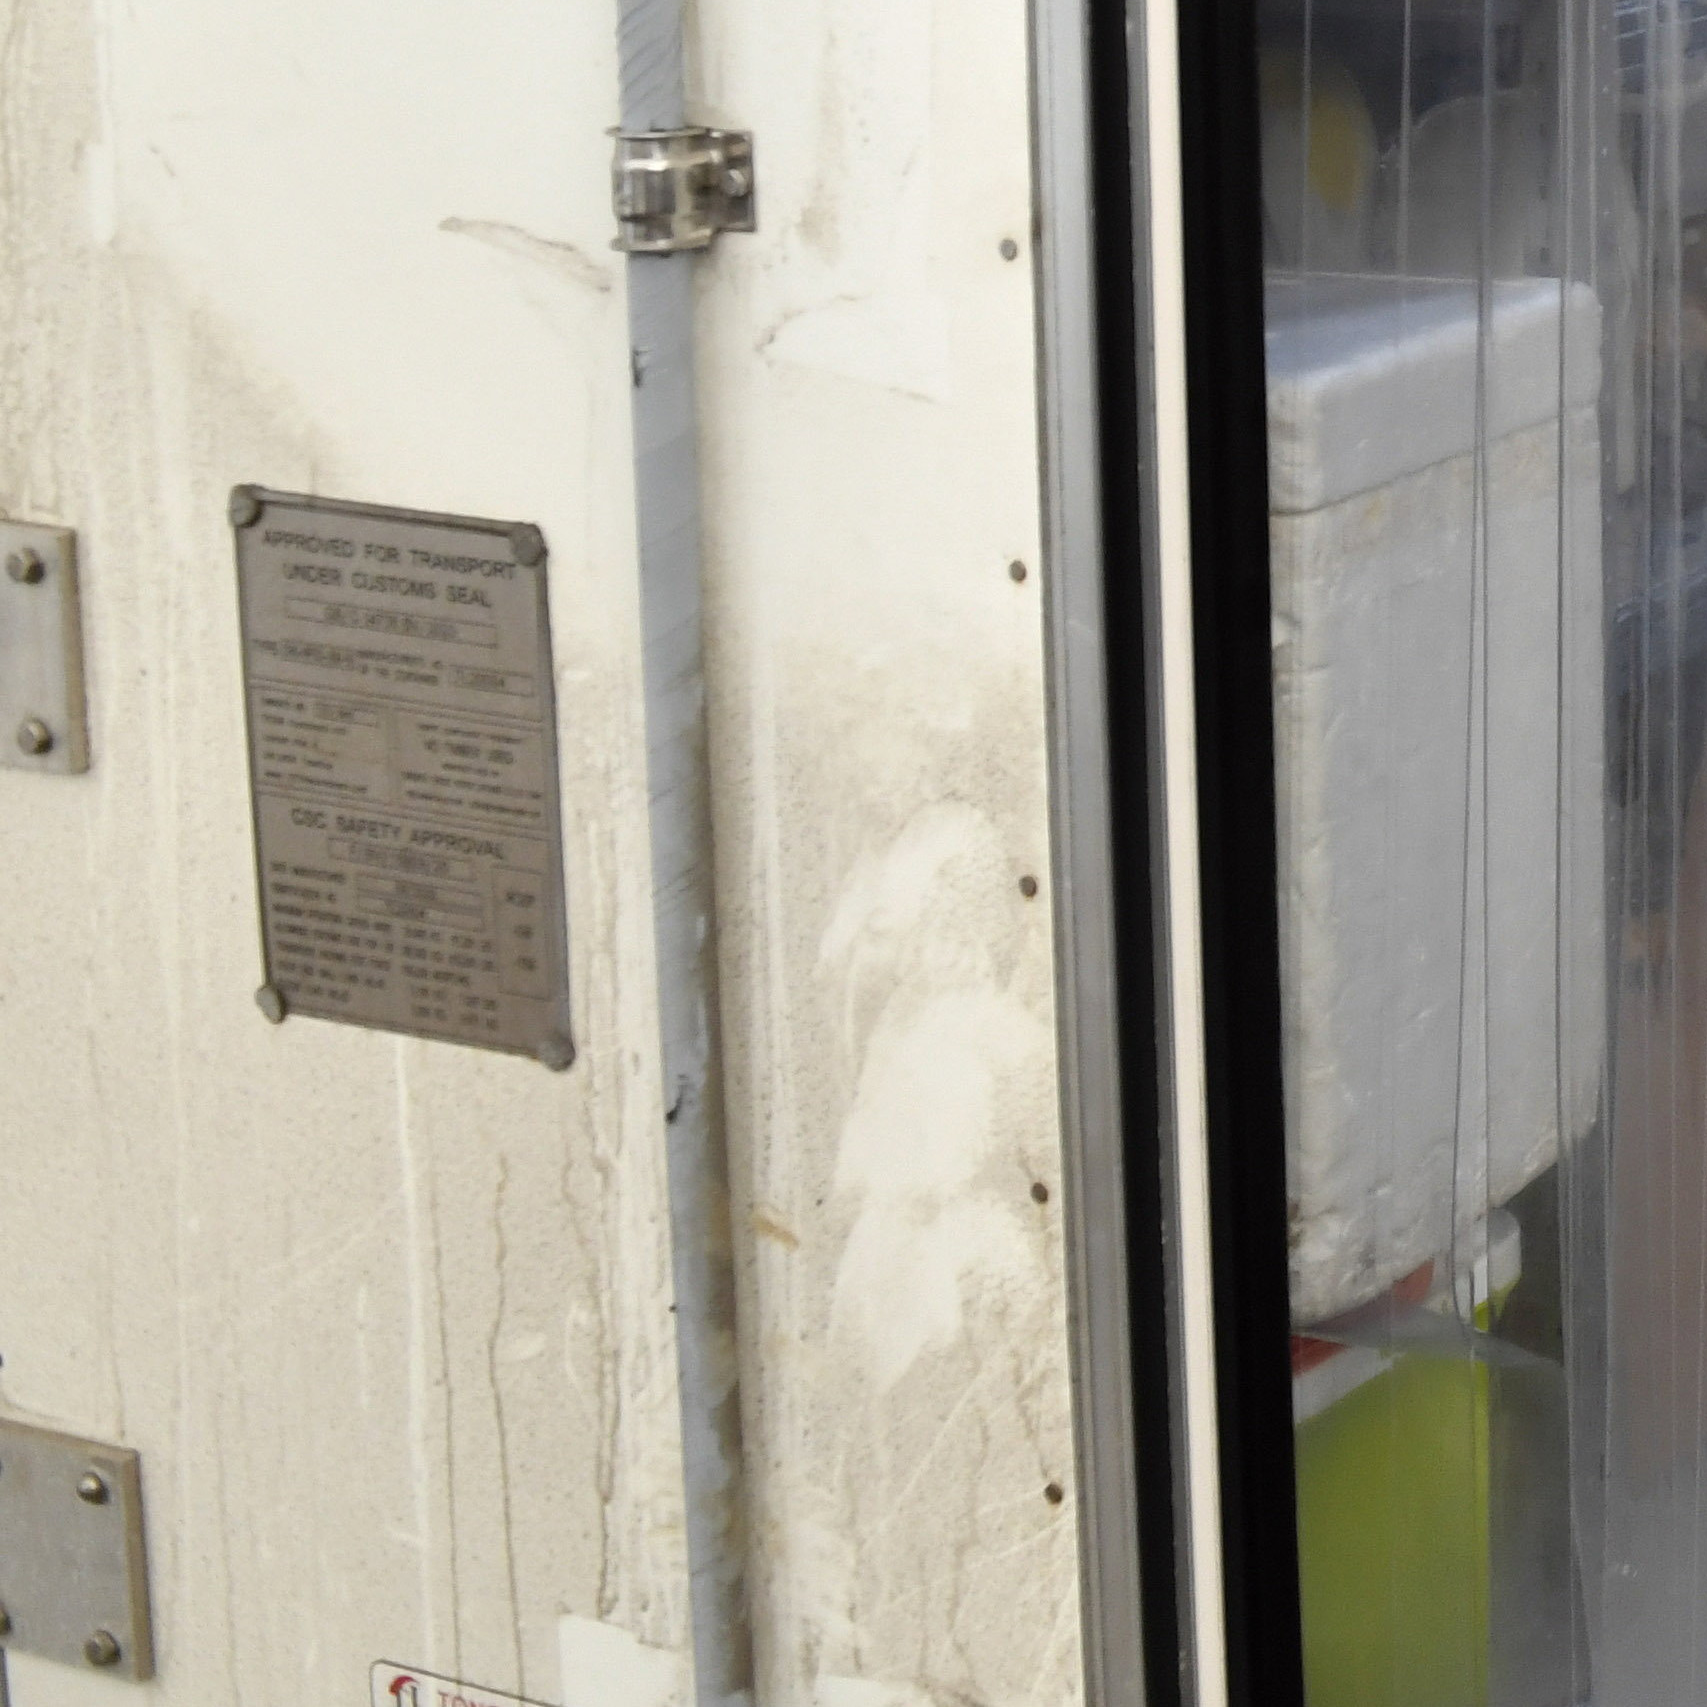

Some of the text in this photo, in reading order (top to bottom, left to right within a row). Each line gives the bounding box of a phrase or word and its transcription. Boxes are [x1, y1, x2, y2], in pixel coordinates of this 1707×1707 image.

[364, 543, 400, 564] FOR
[409, 548, 516, 581] TRANSPORT
[351, 571, 436, 600] CUSTOMS
[446, 584, 492, 608] SEAL
[335, 813, 401, 840] SAFETY
[410, 828, 505, 861] APPROVAL
